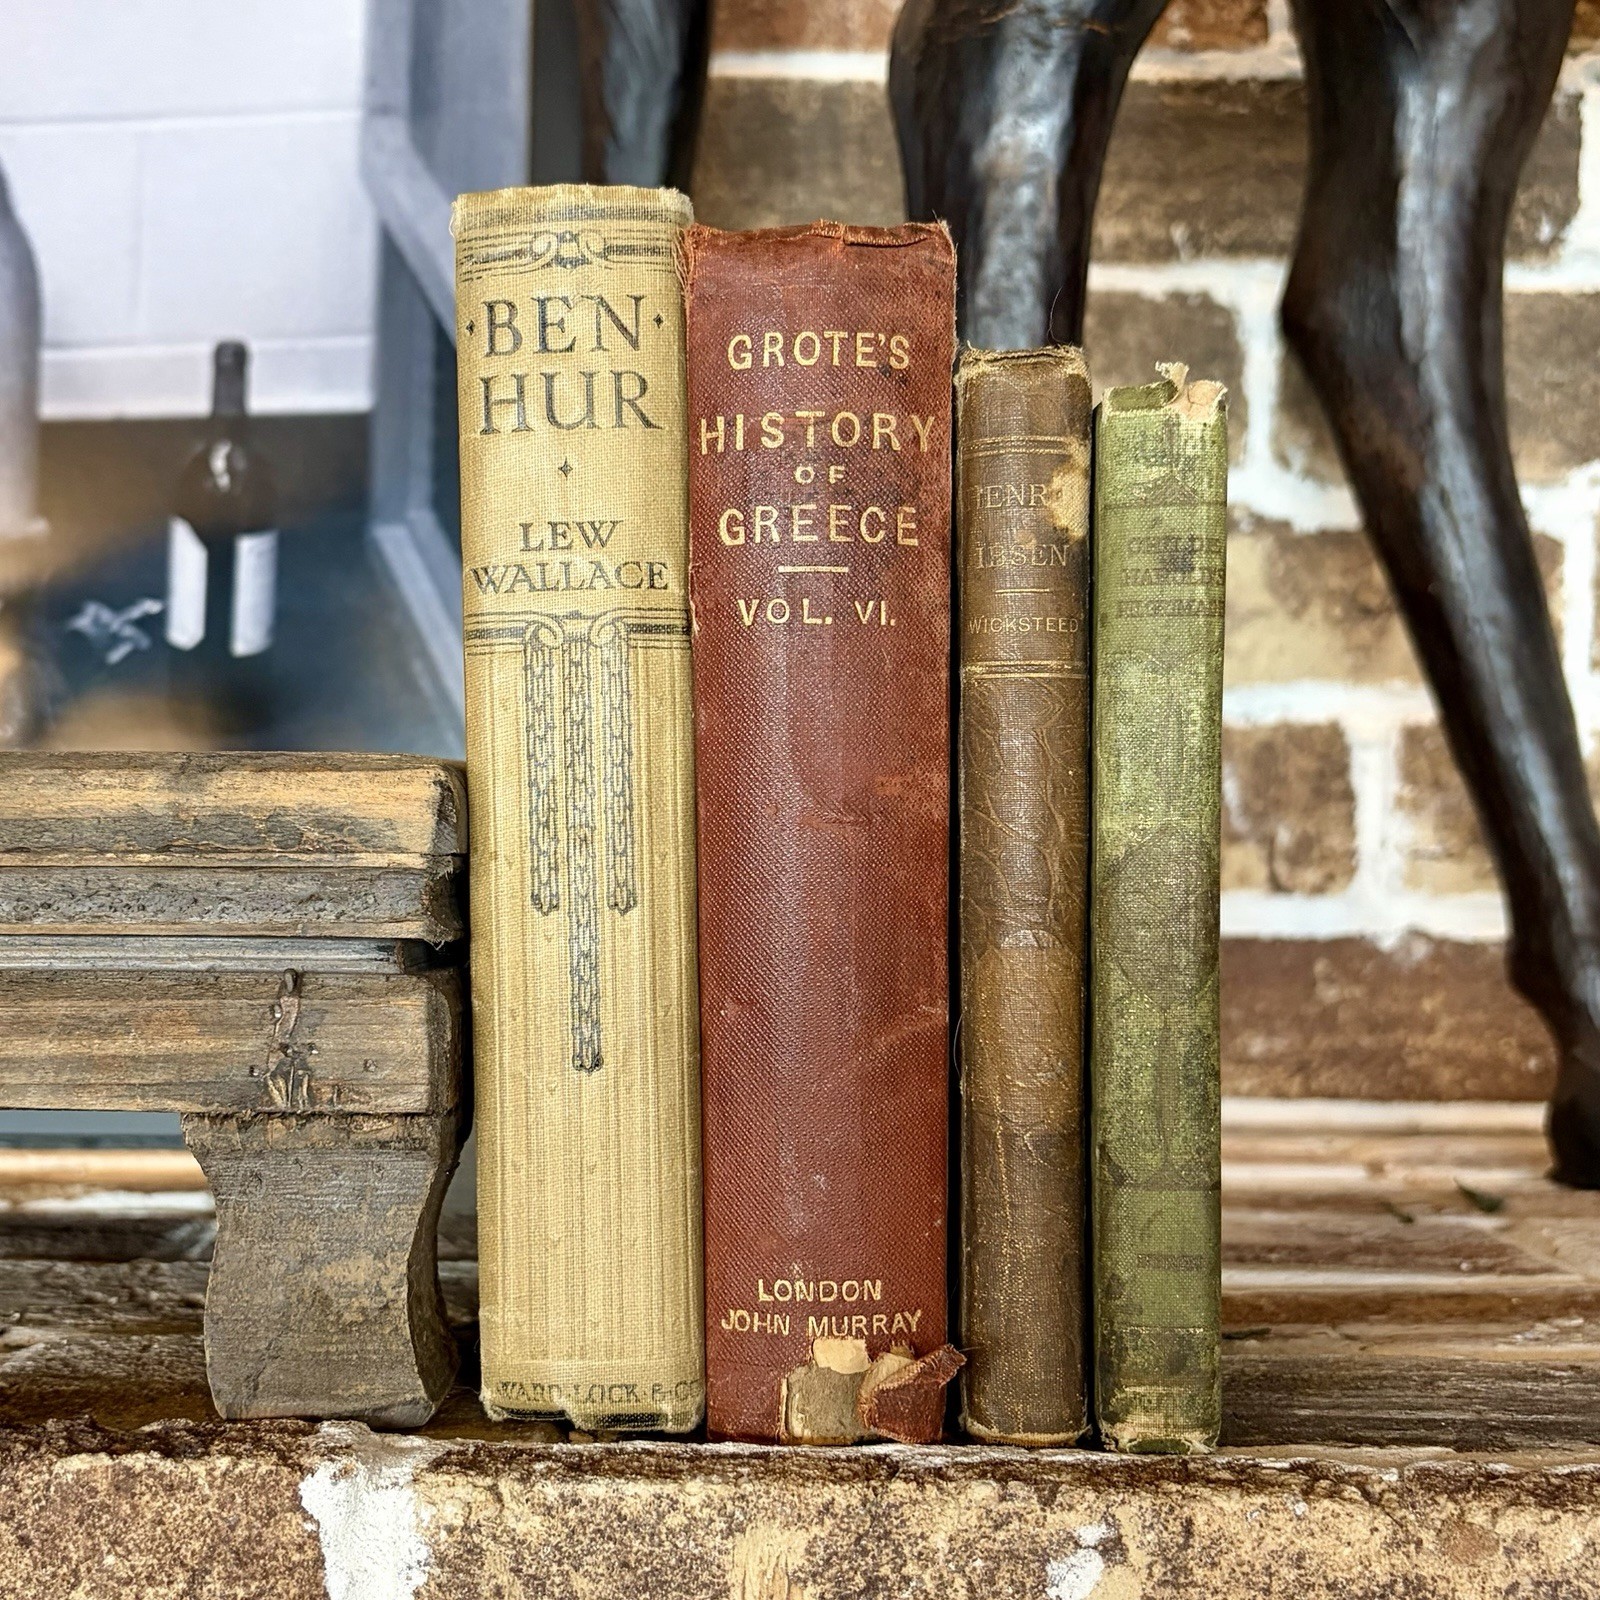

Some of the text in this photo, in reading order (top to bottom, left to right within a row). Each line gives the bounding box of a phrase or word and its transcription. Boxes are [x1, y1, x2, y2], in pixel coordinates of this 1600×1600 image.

[484, 295, 647, 357] BEN
[727, 331, 910, 370] GROTE'S
[480, 370, 663, 436] HUR
[700, 411, 935, 455] HISTORY
[794, 465, 846, 485] OF
[519, 520, 624, 552] LEW
[718, 504, 919, 546] GREECE
[975, 544, 1070, 569] IBSEN
[470, 561, 668, 594] WALLACE
[737, 598, 896, 627] VOL. VI.
[968, 615, 1079, 634] WICKSTEED
[757, 1277, 882, 1303] LONDON
[721, 1309, 922, 1339] JOHN MURRAY
